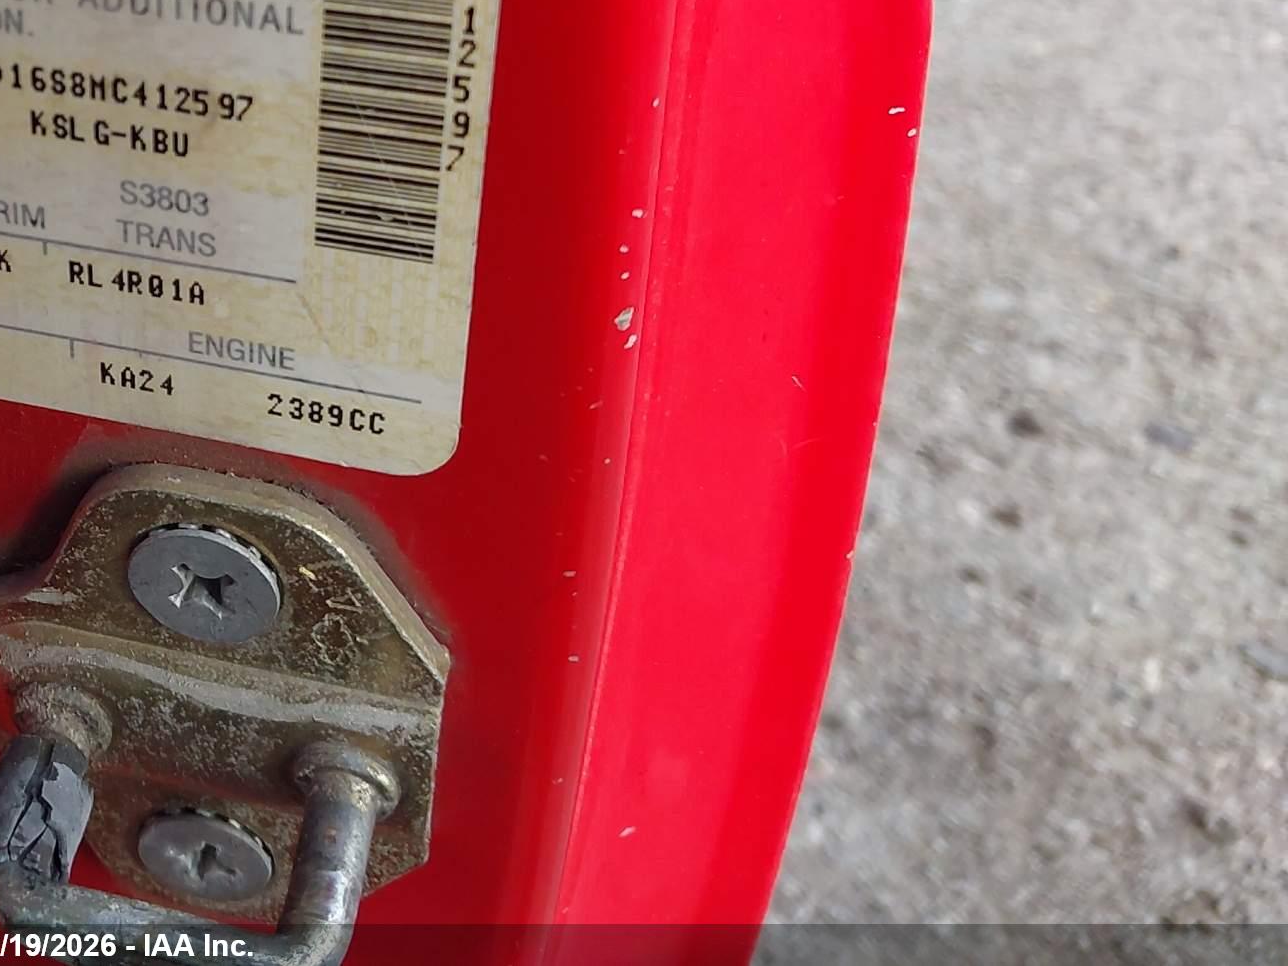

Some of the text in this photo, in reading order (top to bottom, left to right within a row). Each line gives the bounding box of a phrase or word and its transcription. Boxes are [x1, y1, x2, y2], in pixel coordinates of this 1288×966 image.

[30, 110, 189, 158] KSLG-KBU
[120, 181, 209, 217] S3803
[116, 220, 217, 259] TRANS
[188, 330, 295, 371] ENGINE
[100, 361, 175, 396] KA24
[267, 393, 386, 436] 2389CC
